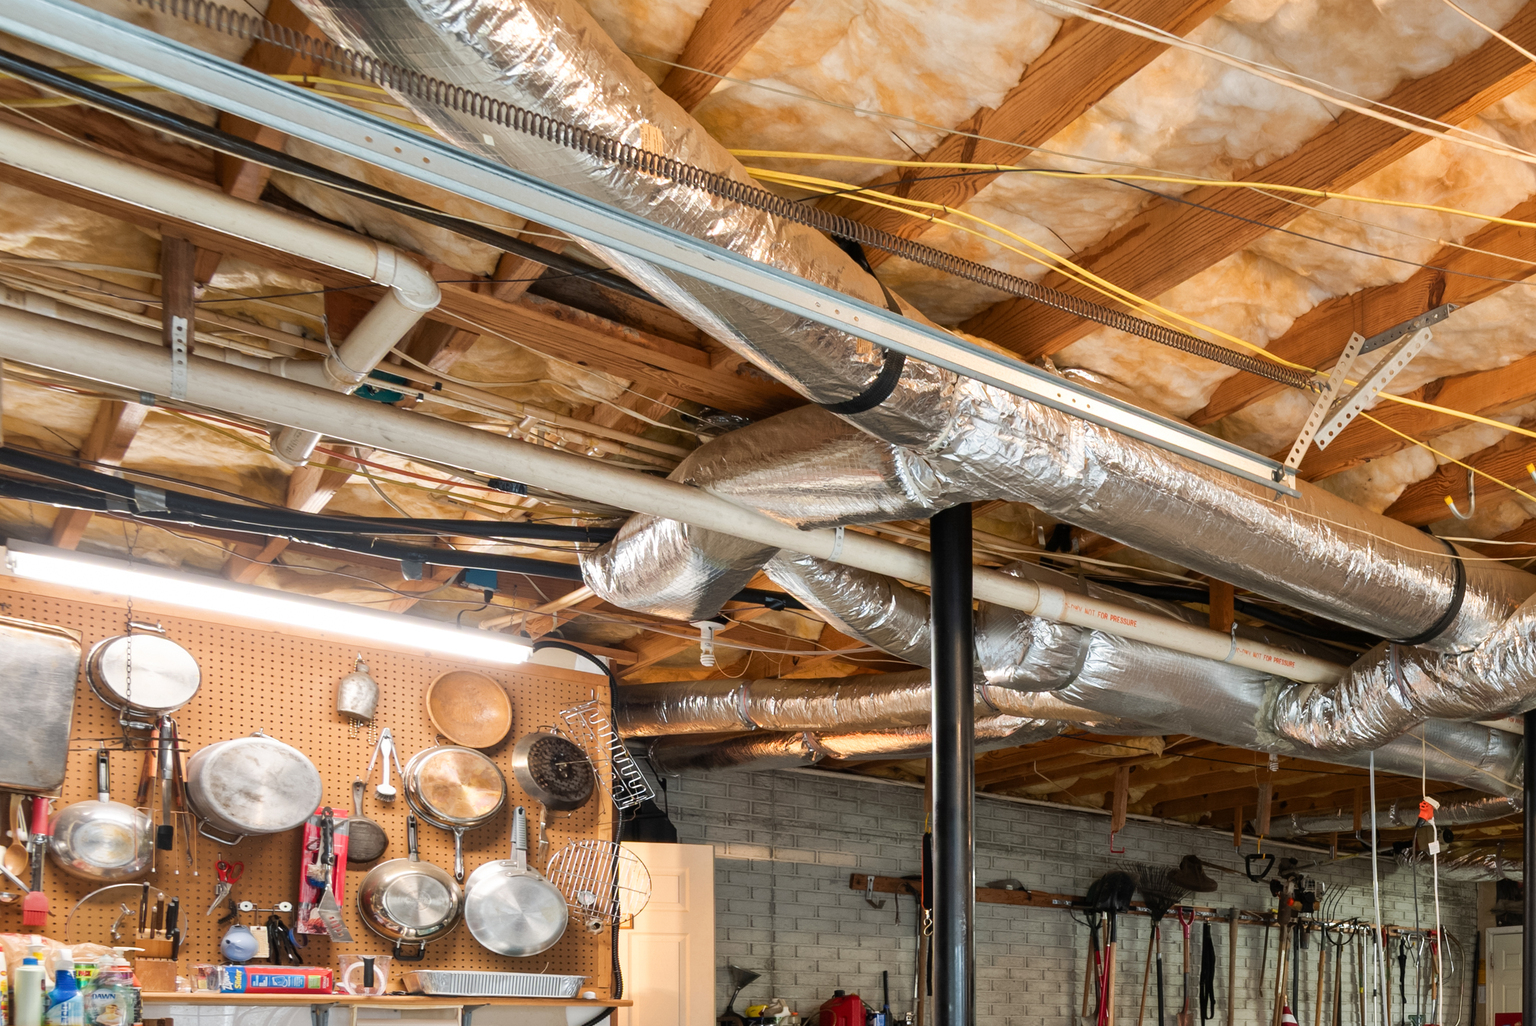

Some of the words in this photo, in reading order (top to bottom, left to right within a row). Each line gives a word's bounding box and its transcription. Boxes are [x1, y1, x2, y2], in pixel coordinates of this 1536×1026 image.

[1084, 608, 1095, 616] NOT
[1097, 611, 1108, 620] FOR
[1109, 614, 1137, 628] PRESSURE
[1263, 654, 1272, 663] FOR
[1273, 656, 1295, 668] PRESSURE
[234, 969, 242, 989] Slider
